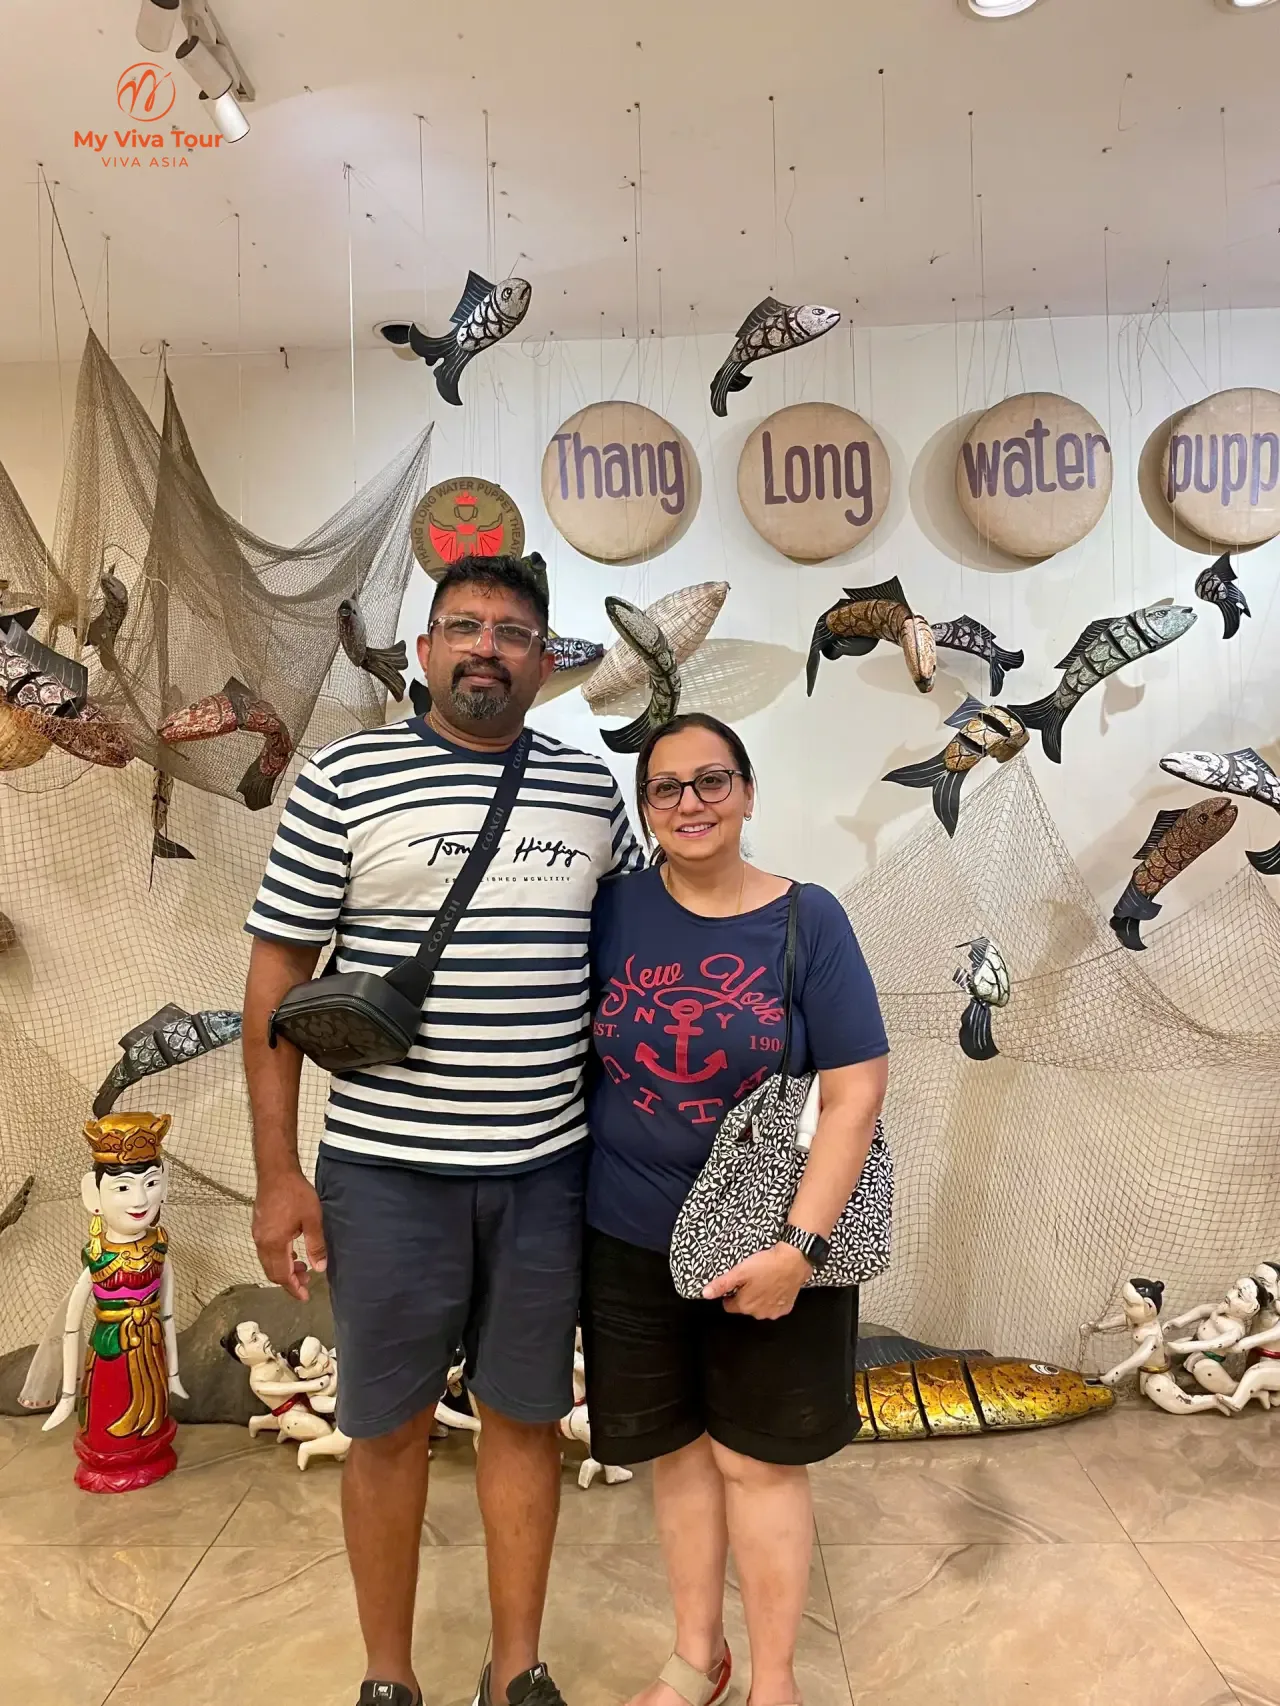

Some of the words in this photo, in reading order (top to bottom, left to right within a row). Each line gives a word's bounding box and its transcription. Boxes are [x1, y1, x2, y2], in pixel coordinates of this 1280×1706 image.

[436, 481, 474, 498] WATER
[551, 431, 686, 515] Thang
[762, 430, 874, 527] Long
[962, 418, 1111, 498] water
[1167, 431, 1280, 507] pupp
[416, 495, 437, 525] LONG
[477, 483, 515, 514] PUPPET
[414, 527, 431, 566] THANG
[509, 515, 521, 561] THEATR
[512, 734, 527, 769] COACH
[481, 807, 504, 851] COACH
[428, 900, 461, 953] COACH
[602, 954, 685, 1016] New
[653, 953, 785, 1026] York
[634, 1007, 656, 1024] N
[716, 1013, 736, 1029] Y
[750, 1035, 784, 1053] 190
